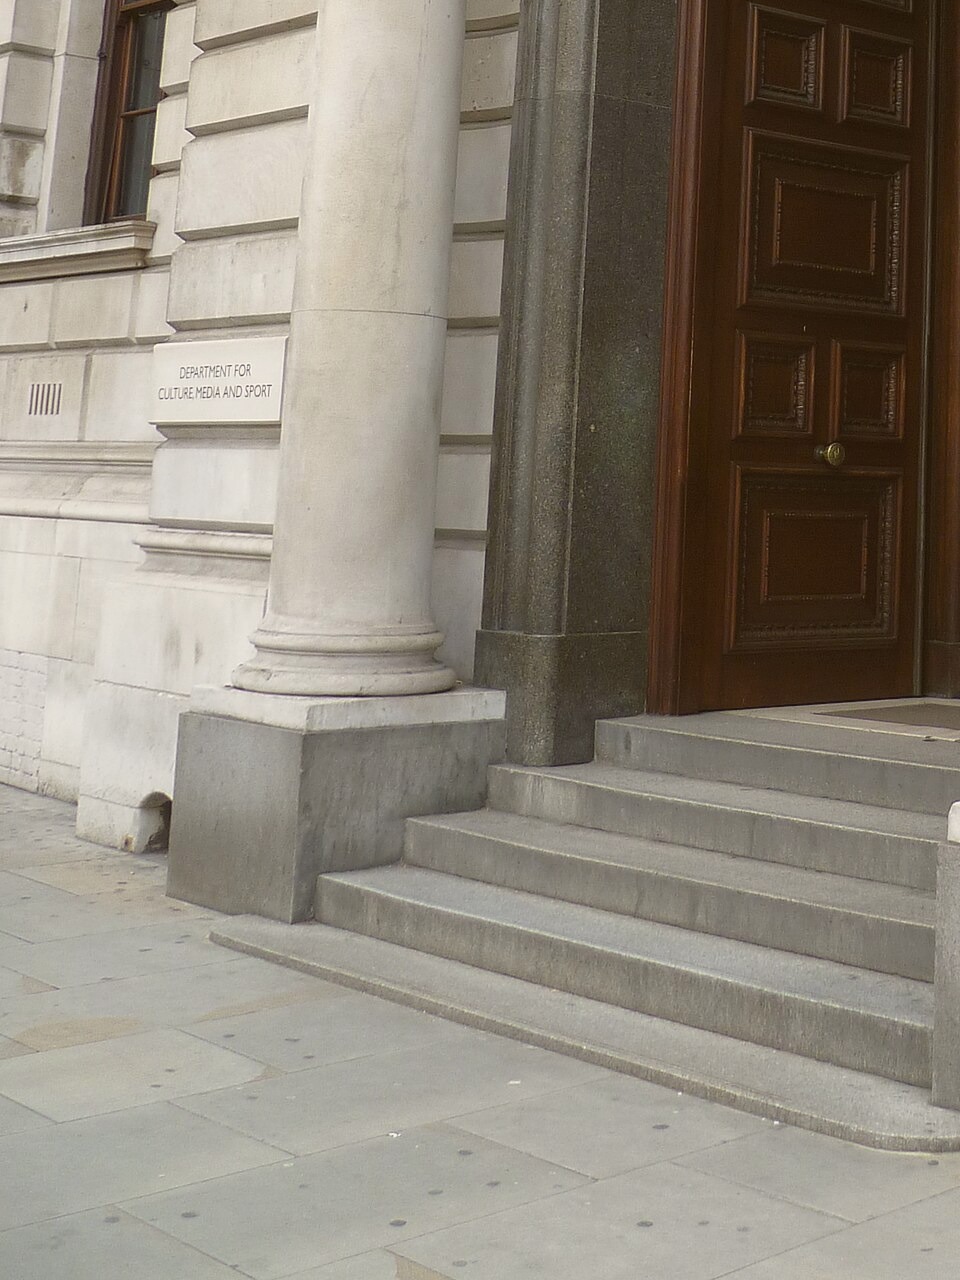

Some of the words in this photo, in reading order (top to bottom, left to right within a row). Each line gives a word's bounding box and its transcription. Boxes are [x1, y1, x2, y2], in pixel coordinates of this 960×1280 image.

[179, 365, 232, 379] DEPARTMENT
[234, 363, 251, 377] FOR
[195, 386, 220, 399] MEDIA
[222, 385, 243, 398] AND
[244, 384, 272, 398] SPORT
